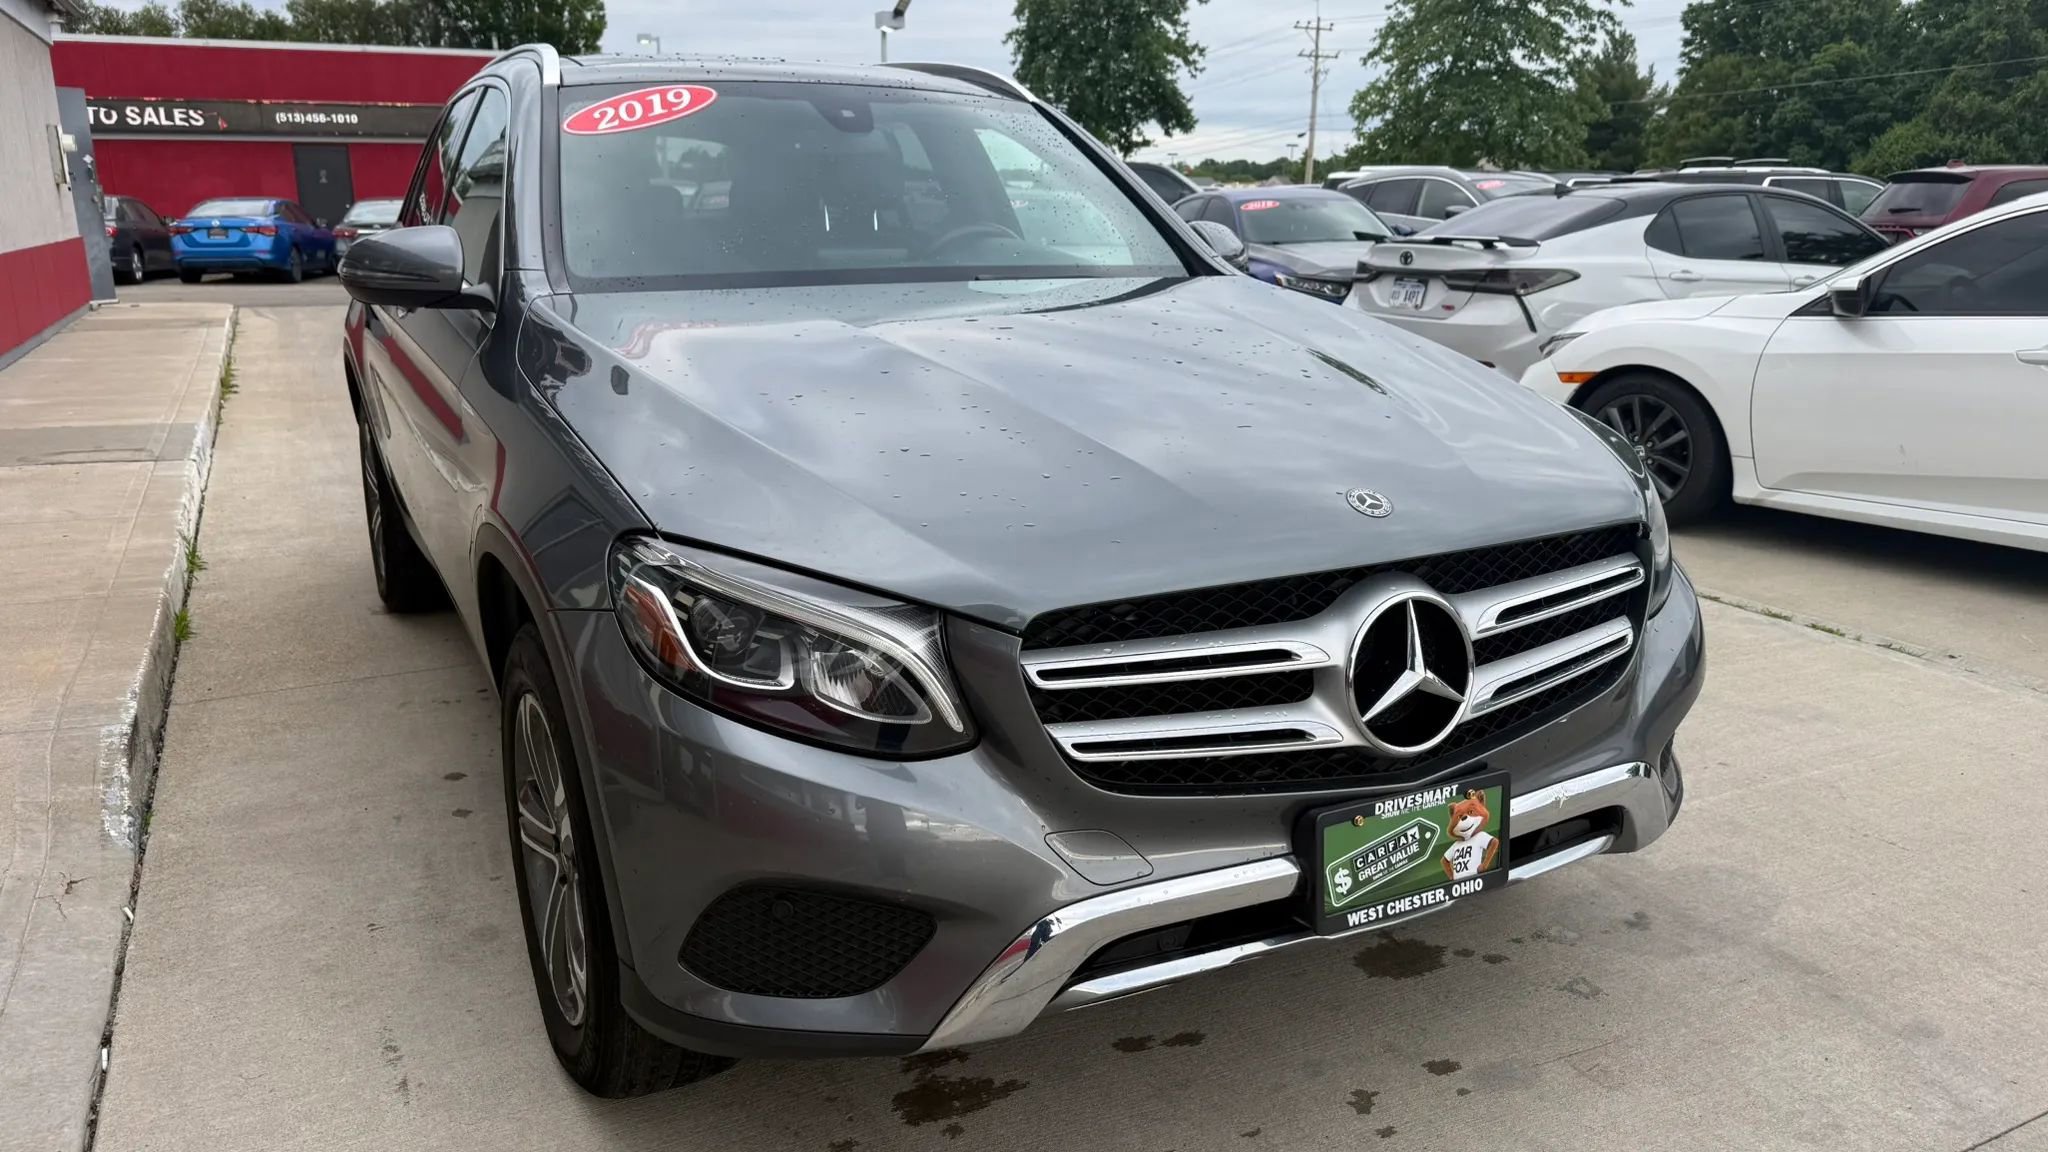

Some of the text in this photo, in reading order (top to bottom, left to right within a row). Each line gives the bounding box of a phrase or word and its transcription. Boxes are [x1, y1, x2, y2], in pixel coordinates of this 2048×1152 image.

[125, 106, 205, 127] SALES
[593, 88, 691, 130] 2019
[1374, 784, 1459, 816] DRIVESMART
[1356, 830, 1418, 868] CARFAX
[1358, 859, 1388, 881] GREAT
[1389, 842, 1420, 864] VALUE
[1453, 846, 1472, 861] CAR
[1347, 878, 1483, 927] WEST CHESTER, OHIO
